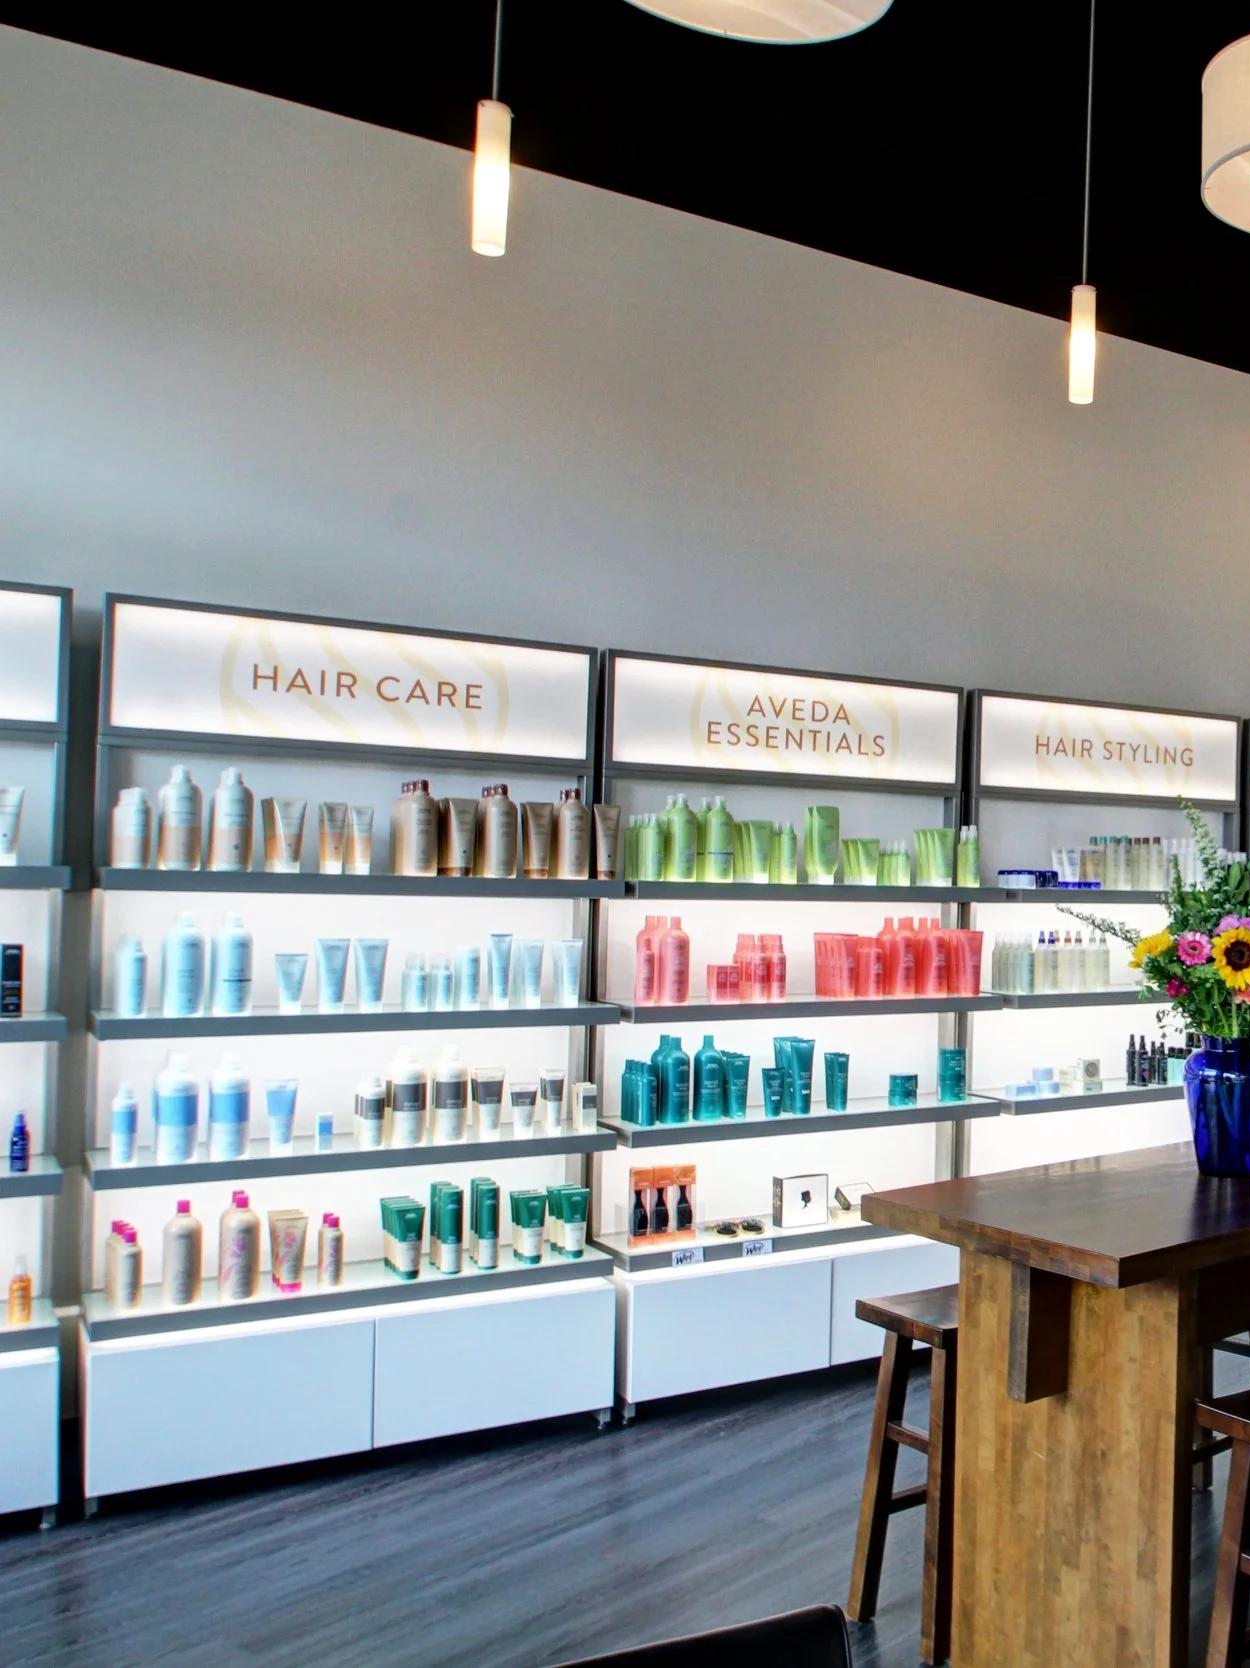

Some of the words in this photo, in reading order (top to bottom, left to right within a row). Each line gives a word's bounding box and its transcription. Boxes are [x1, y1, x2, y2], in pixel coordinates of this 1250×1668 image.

[252, 663, 358, 699] HAIR
[375, 675, 484, 710] CARE
[746, 695, 851, 726] AVEDA
[707, 720, 886, 757] ESSENTIALS
[1035, 735, 1093, 759] HAIR
[1103, 740, 1195, 768] STYLING
